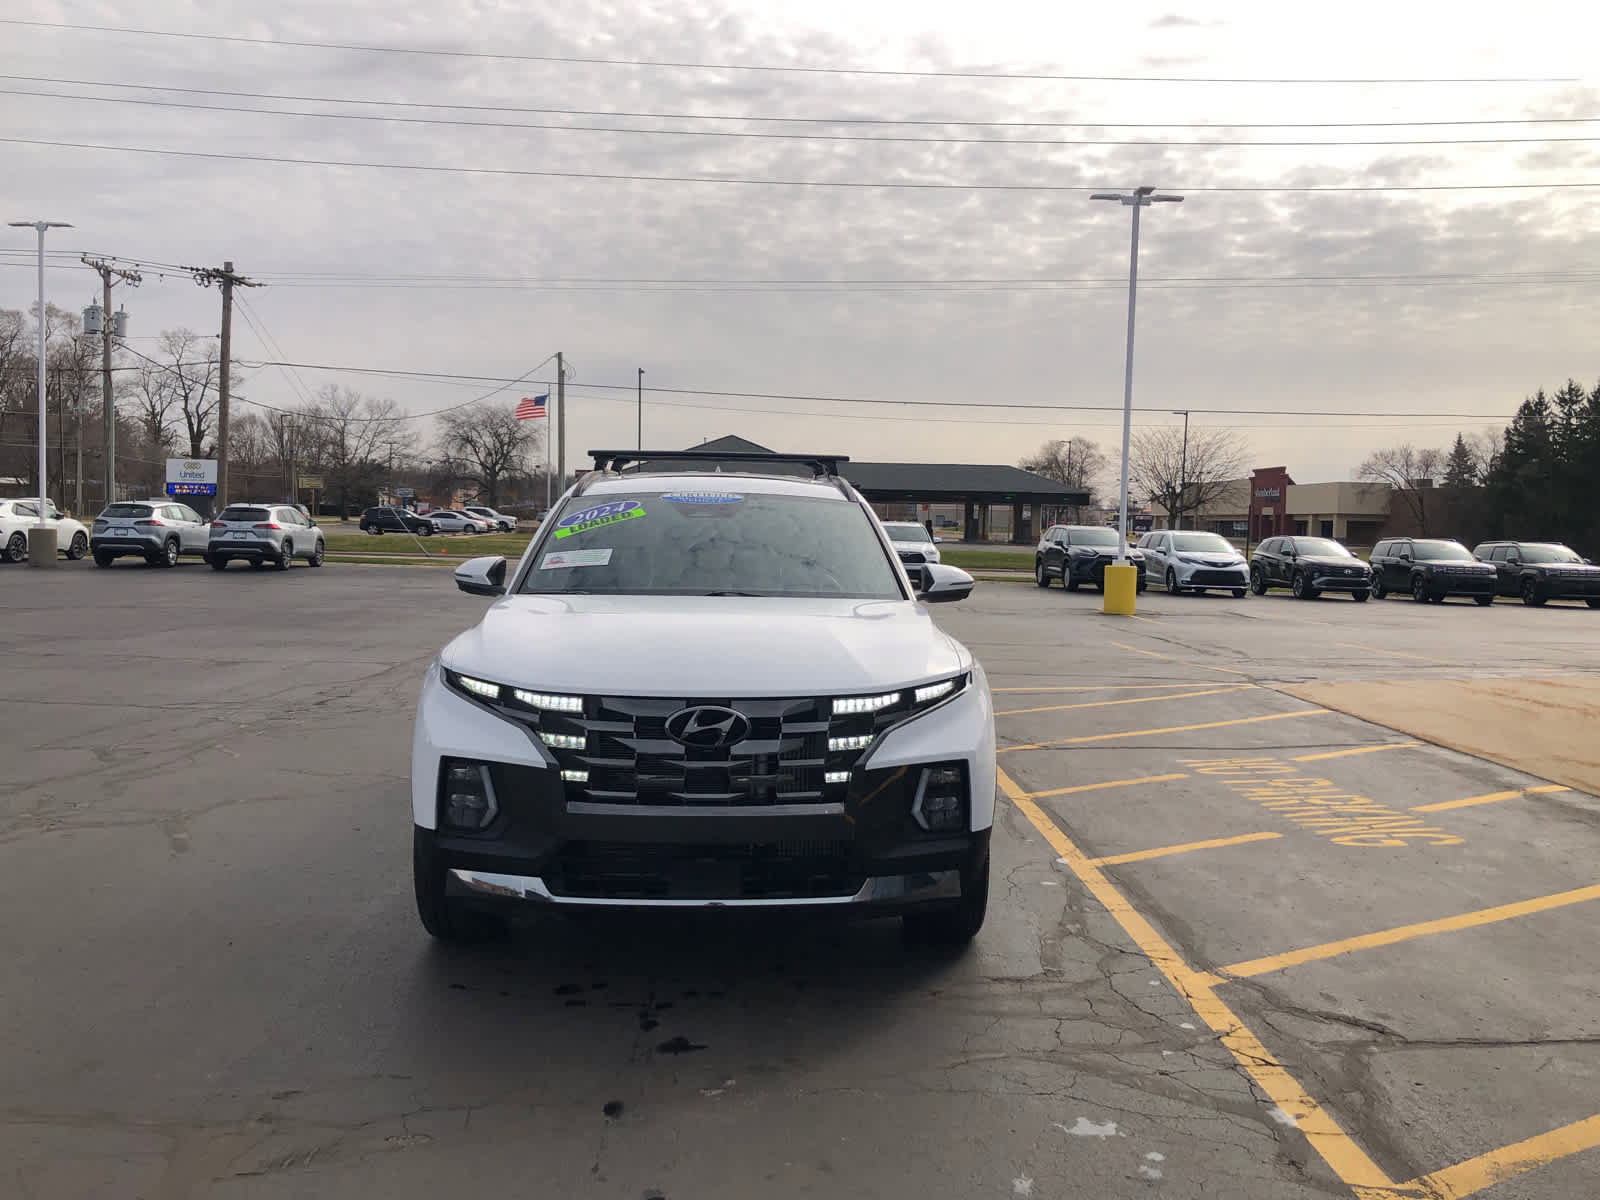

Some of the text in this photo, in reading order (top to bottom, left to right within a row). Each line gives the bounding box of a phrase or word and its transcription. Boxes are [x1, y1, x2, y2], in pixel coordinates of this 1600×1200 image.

[180, 471, 205, 479] United
[569, 511, 633, 533] LOADED
[574, 502, 626, 524] 2024
[1175, 757, 1466, 847] NO PARKING
